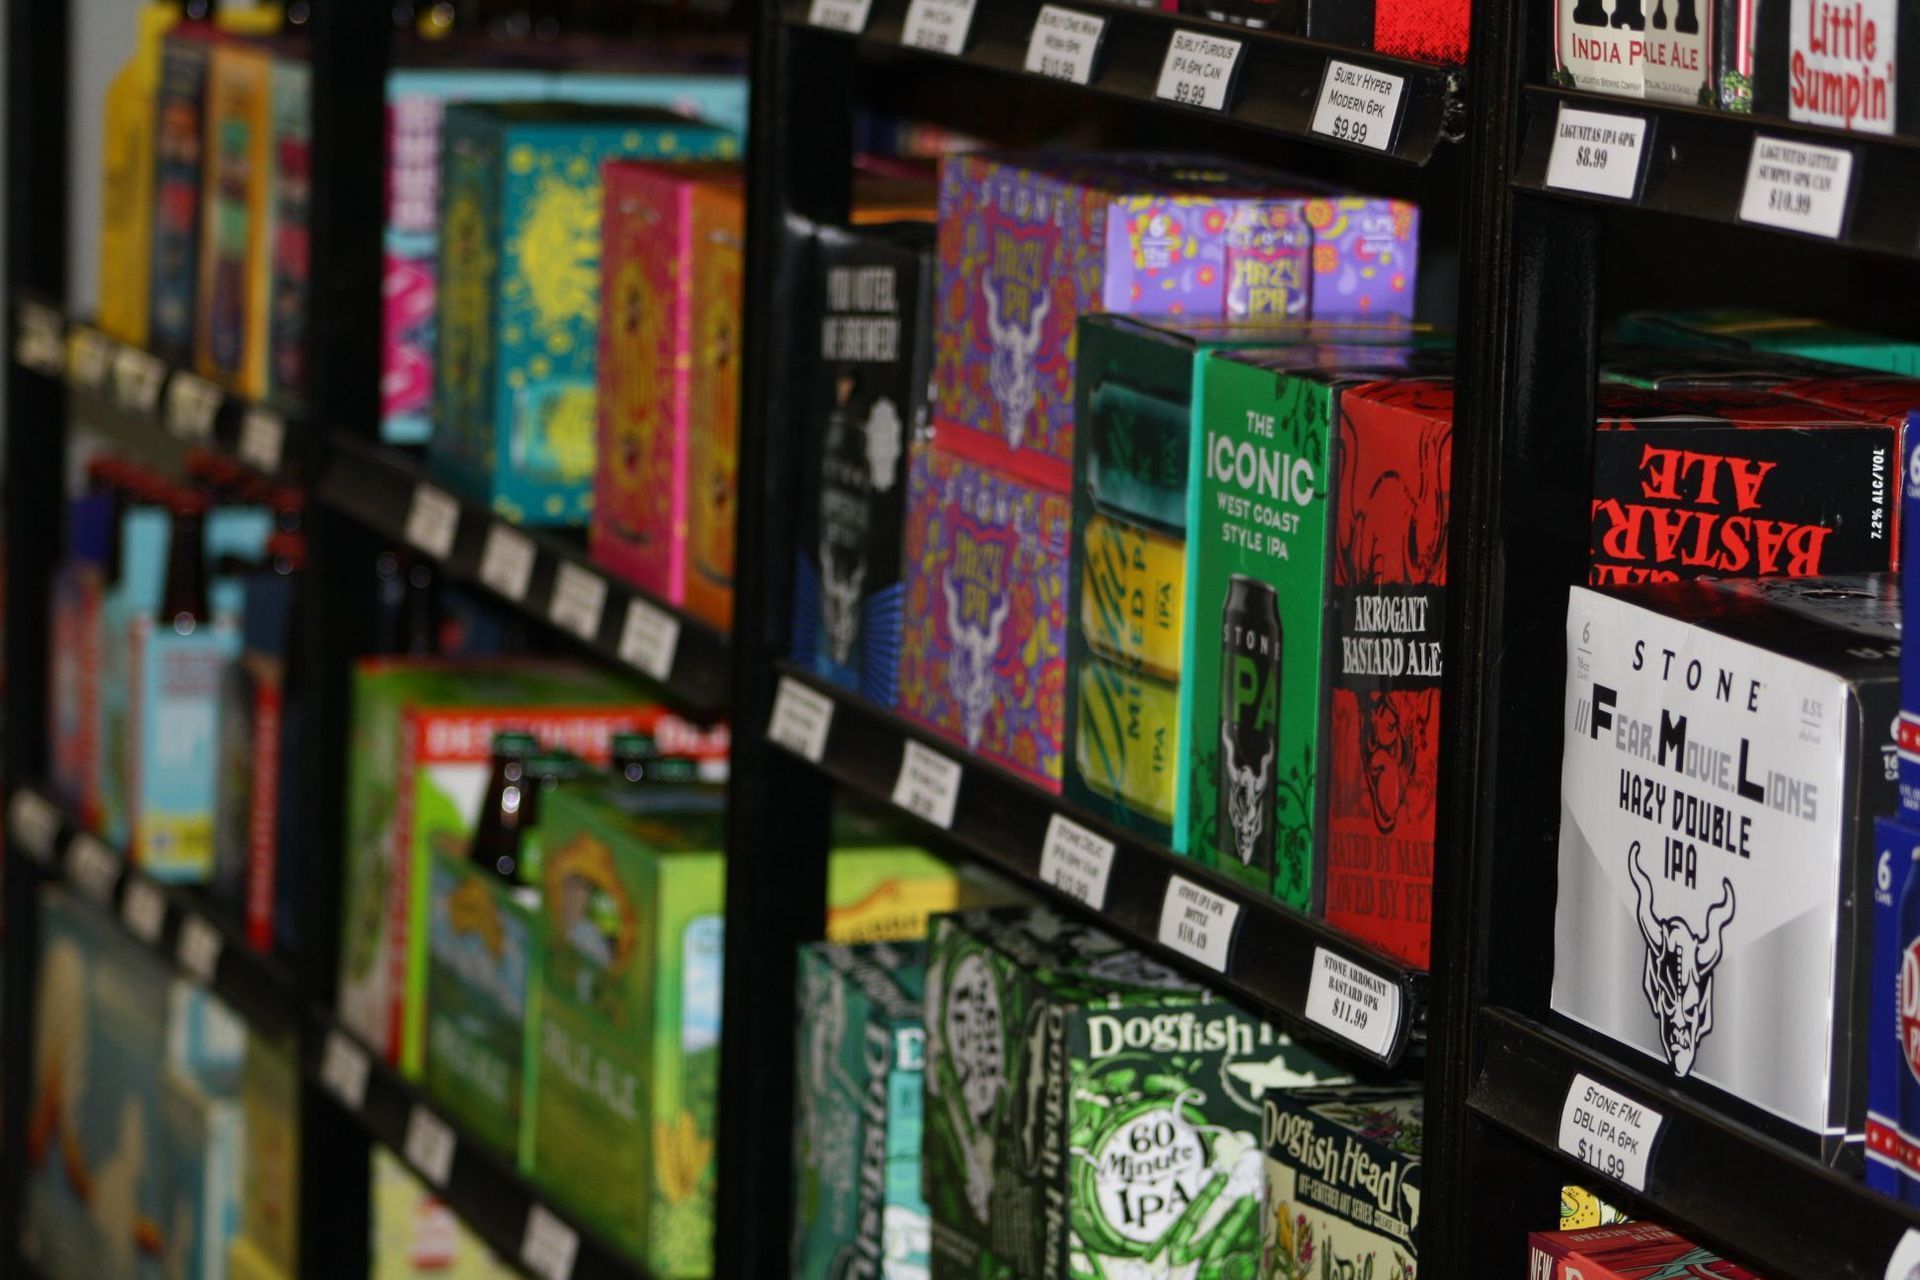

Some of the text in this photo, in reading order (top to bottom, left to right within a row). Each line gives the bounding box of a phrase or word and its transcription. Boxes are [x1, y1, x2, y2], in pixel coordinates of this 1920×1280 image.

[1809, 0, 1876, 61] Little
[1572, 33, 1699, 71] INDIA PALE ALE
[1334, 66, 1393, 95] SURLY HYPER
[1791, 50, 1893, 131] Sumpin'
[1328, 89, 1385, 118] MODERN 6PK
[1332, 114, 1367, 143] $9.99
[1576, 145, 1608, 169] $8.99
[1246, 411, 1275, 438] THE
[1207, 431, 1315, 507] ICONIC
[1639, 444, 1777, 512] ALE
[1217, 492, 1300, 535] WEST COAST
[1871, 448, 1885, 540] 7.2% ALC/VOL
[1222, 523, 1289, 560] STYLE IPA
[1591, 498, 1833, 578] BASTAR
[1354, 595, 1428, 633] ARROGANT
[1582, 621, 1591, 644] 6
[1224, 623, 1280, 660] STONE
[1342, 637, 1443, 677] BASTARD ALE
[1631, 639, 1762, 714] STONE
[1619, 769, 1752, 859] HAZY DOUBLE
[1664, 836, 1697, 891] IPA
[1876, 849, 1893, 891] 6
[1324, 955, 1387, 997] STONE ARROGANT
[1328, 976, 1379, 1011] BASTARD 6PK
[1332, 997, 1368, 1030] $11.99
[1087, 1012, 1254, 1059] Dogfish
[1584, 1086, 1641, 1129] STONE FML
[1129, 1121, 1176, 1153] 60
[1573, 1107, 1639, 1156] DBL IPA 6PK
[1109, 1146, 1194, 1183] Minute
[1263, 1100, 1398, 1212] Dogfish Head
[1577, 1137, 1625, 1180] $11.99
[1117, 1181, 1190, 1229] IPA
[1530, 1247, 1553, 1280] NEW
